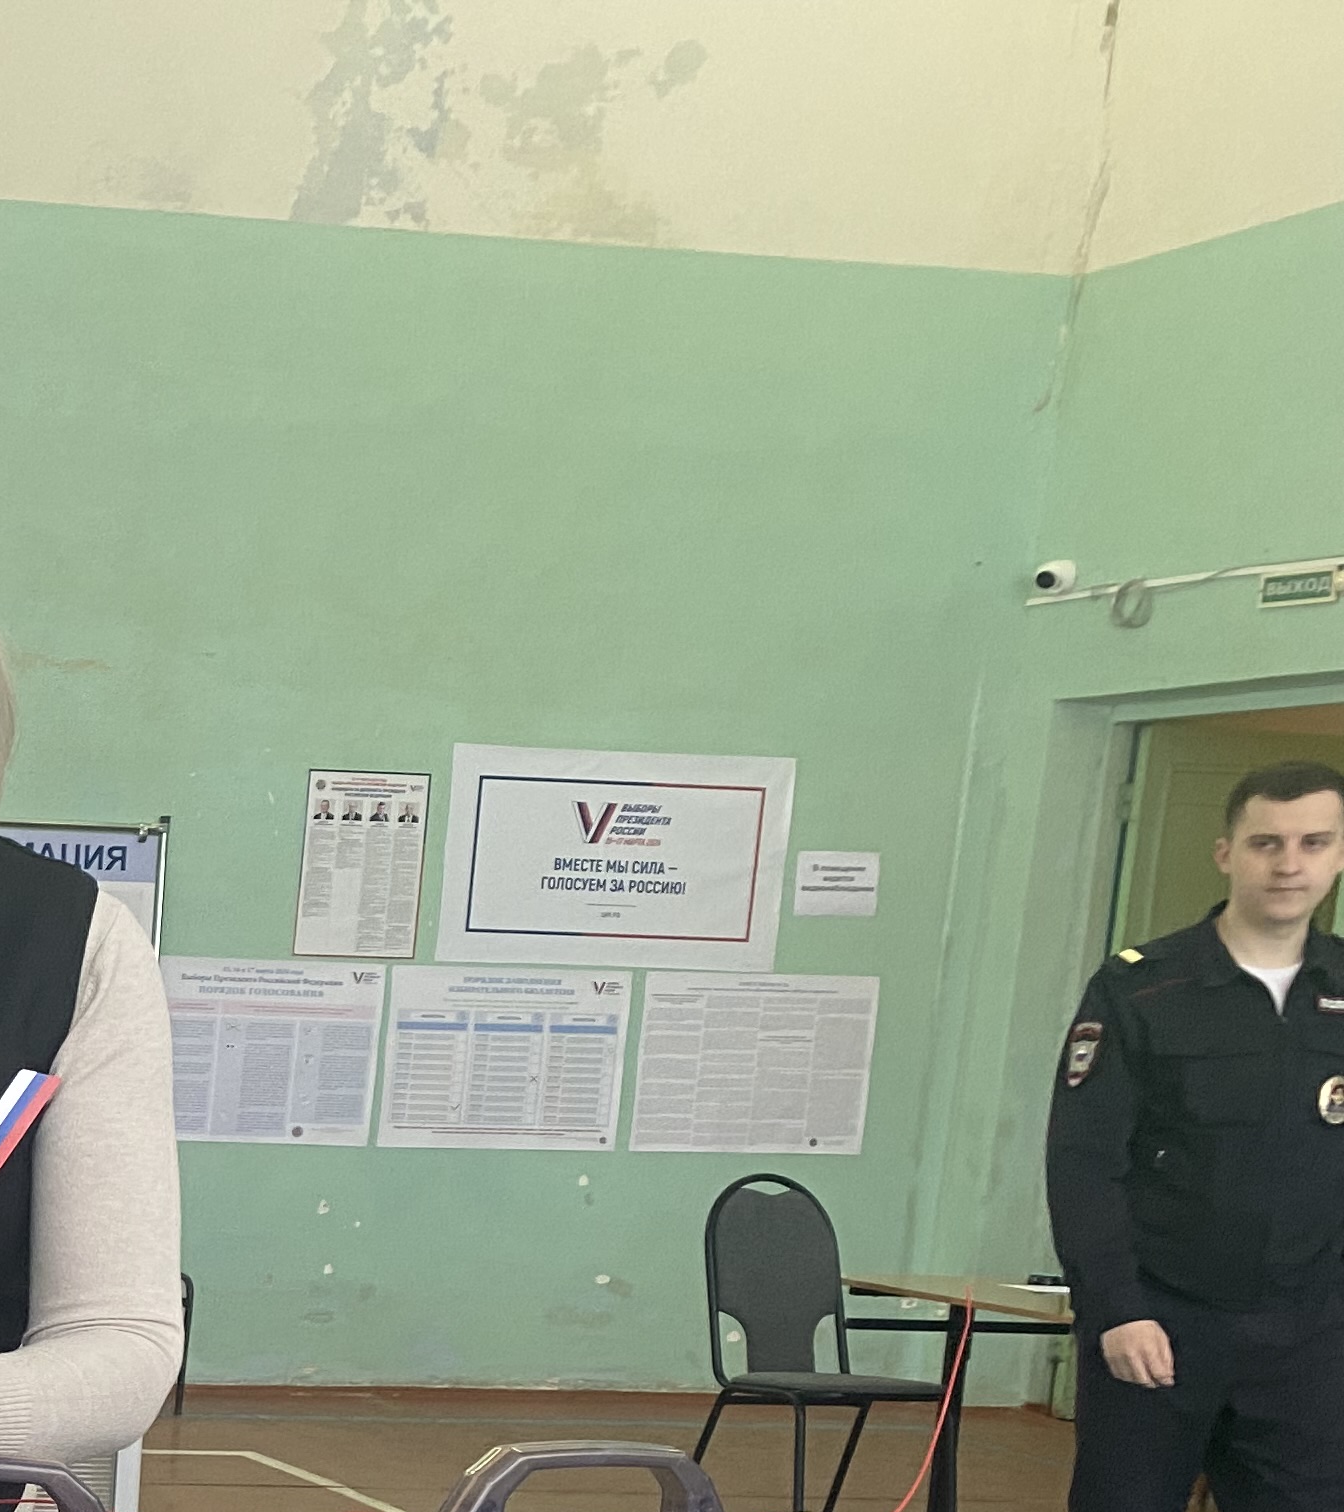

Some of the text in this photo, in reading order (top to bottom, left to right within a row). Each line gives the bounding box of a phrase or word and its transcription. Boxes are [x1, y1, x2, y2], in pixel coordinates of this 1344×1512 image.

[620, 803, 663, 814] ВЫБОРЫ
[615, 814, 673, 826] ПРЕЗИДЕНТА
[554, 857, 604, 873] ВМЕСТЕ
[606, 860, 629, 874] МЫ
[631, 860, 666, 875] СИЛА
[541, 876, 687, 895] ГОЛОСУЕМ ЗА РОССИЮ!
